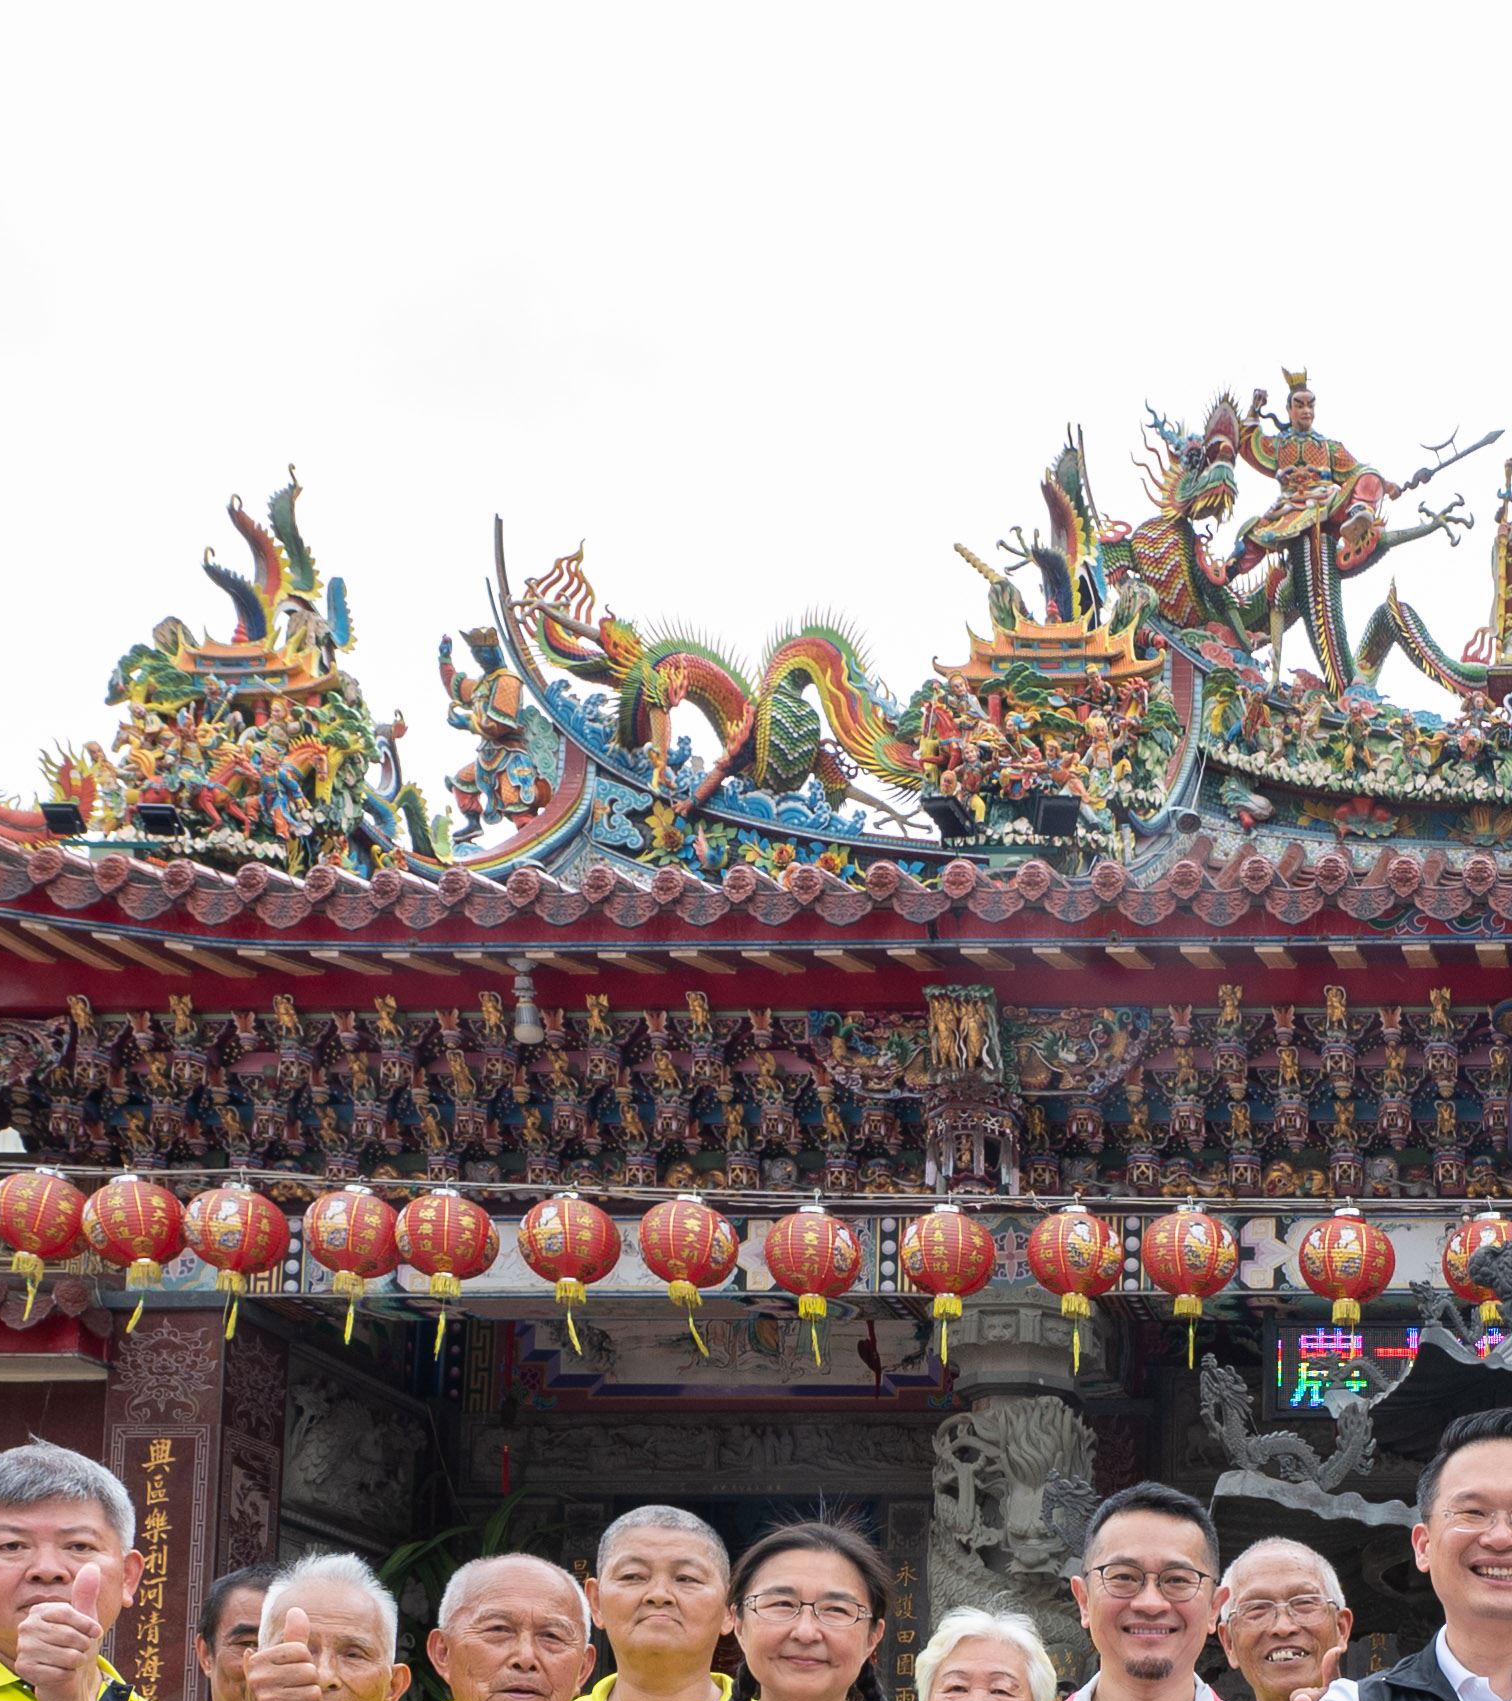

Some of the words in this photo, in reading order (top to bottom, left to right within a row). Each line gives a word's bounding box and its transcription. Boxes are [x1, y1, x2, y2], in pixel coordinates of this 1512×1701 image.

[682, 1205, 704, 1265] 大吉大利
[801, 1218, 821, 1275] 大吉大利
[930, 1217, 951, 1274] 恭喜發財
